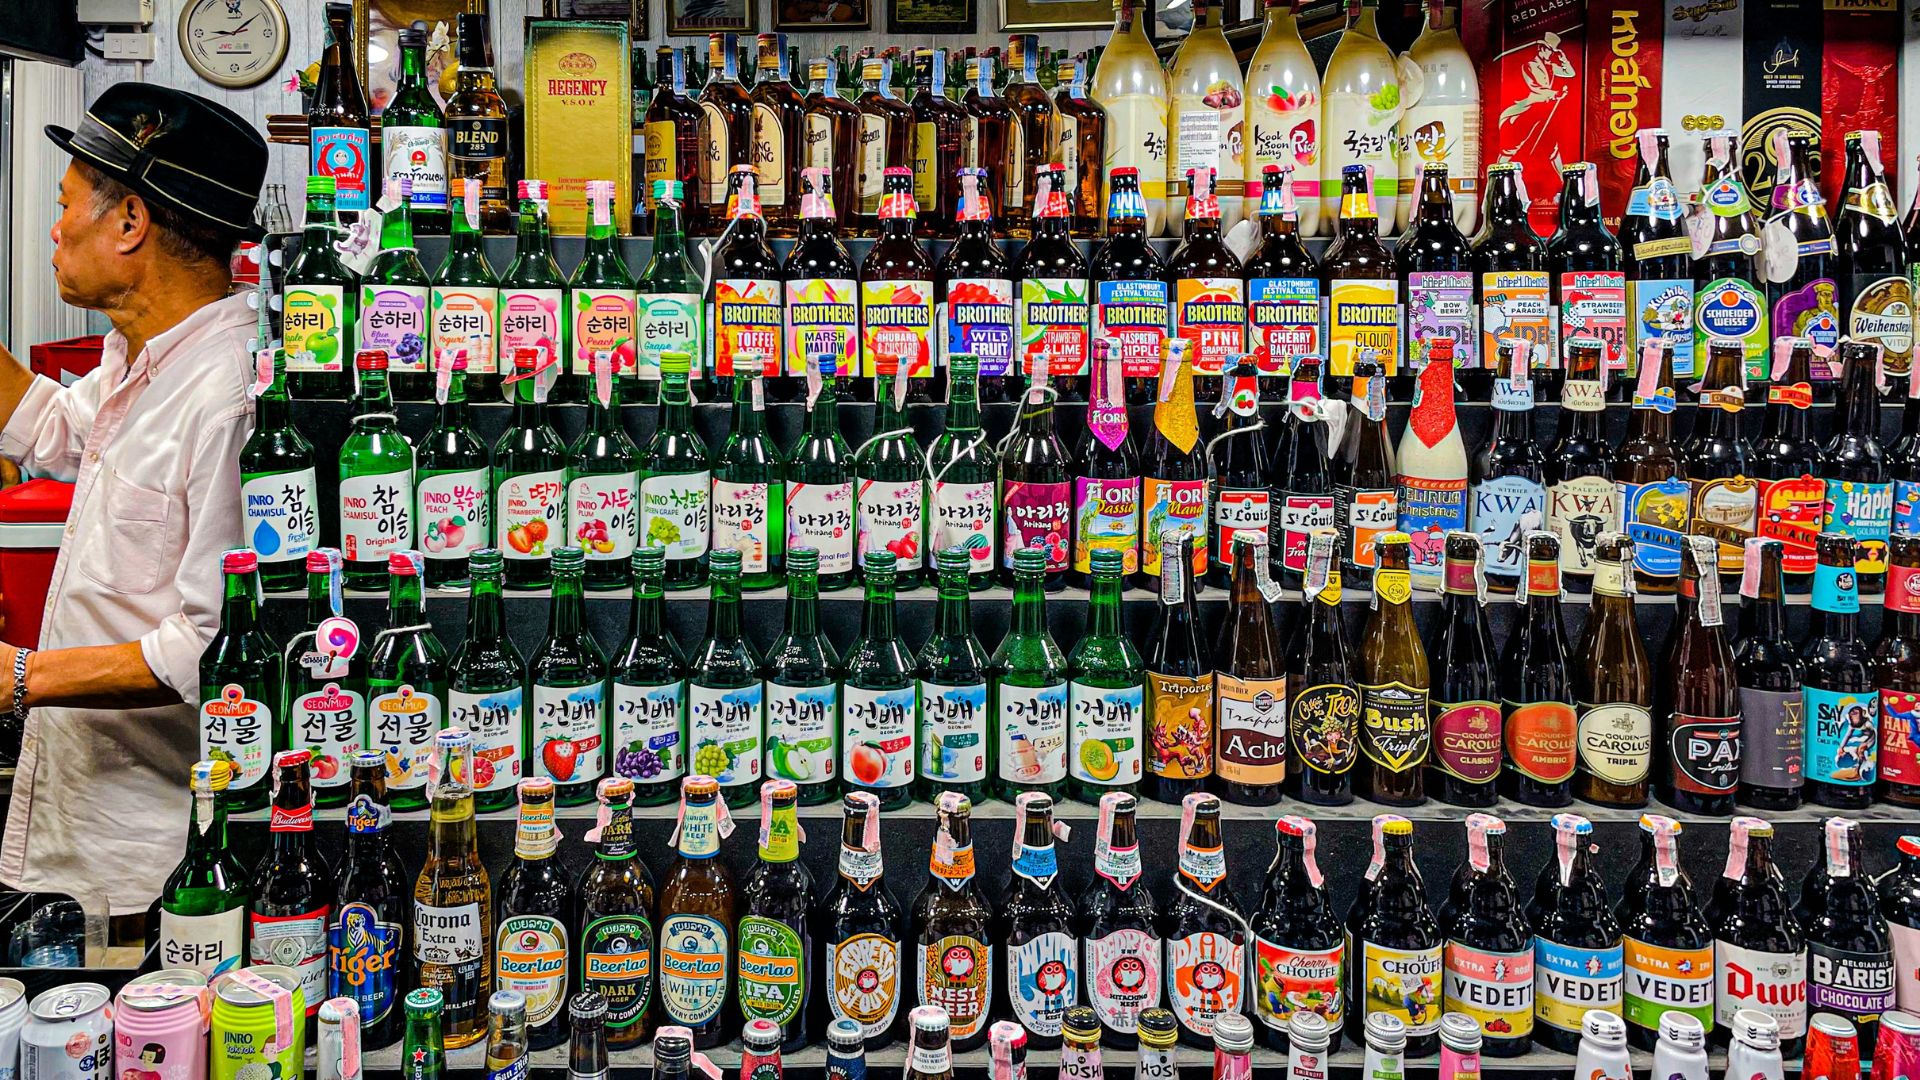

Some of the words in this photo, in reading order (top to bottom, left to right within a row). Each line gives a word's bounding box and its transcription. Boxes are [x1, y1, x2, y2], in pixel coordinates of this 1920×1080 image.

[1511, 8, 1537, 24] RED
[547, 79, 607, 96] REGENCY
[455, 131, 498, 144] BLEND
[1255, 125, 1282, 142] Kook
[469, 143, 486, 151] 285
[1265, 140, 1289, 149] Soon
[1343, 130, 1386, 159] 국순당
[1256, 146, 1282, 159] dang
[285, 312, 324, 331] 순하리
[370, 311, 416, 329] 순하리
[724, 305, 781, 323] BROTHERS
[793, 305, 855, 323] BROTHERS
[867, 307, 929, 325] BROTHERS
[1031, 305, 1087, 323] BROTHERS
[1107, 306, 1166, 324] BROTHERS
[1257, 306, 1318, 324] BROTHERS
[1706, 309, 1754, 319] SCHNEIDER
[439, 314, 483, 332] 순하리
[504, 315, 546, 333] 순하리
[587, 316, 631, 333] 순하리
[645, 321, 688, 338] 순하리
[1713, 318, 1748, 327] WEISSE
[438, 335, 467, 347] Yogurt
[586, 337, 615, 346] Peach
[737, 332, 775, 347] TOFFEE
[805, 333, 845, 341] MARSH
[877, 333, 918, 341] RHUBARB
[971, 332, 1008, 343] WILD
[1043, 333, 1081, 344] STRAWBERRY
[1120, 333, 1159, 345] RASPBERRY
[1202, 332, 1239, 344] PINK
[1271, 333, 1311, 345] CHERRY
[1356, 333, 1392, 347] CLOUDY
[644, 342, 672, 350] Grape
[971, 344, 1008, 356] FRUIT
[248, 494, 274, 506] JINRO
[282, 484, 305, 512] 참
[344, 496, 367, 509] JINRO
[372, 484, 399, 515] 참
[424, 491, 451, 504] JINRO
[508, 498, 527, 507] JINRO
[576, 499, 597, 510] JINRO
[645, 493, 668, 506] JINRO
[1400, 490, 1461, 505] DELIRIUM
[248, 506, 287, 518] CHAMISUL
[343, 508, 379, 520] CHAMISUL
[426, 505, 448, 514] PEACH
[508, 508, 542, 516] STRAWBERRY
[578, 509, 594, 517] PLUM
[660, 508, 679, 516] GRAPE
[715, 503, 764, 524] 아리랑
[868, 501, 920, 521] 아리랑
[939, 504, 992, 523] 아리랑
[1017, 503, 1070, 523] 아리랑
[1235, 509, 1269, 522] Louis
[1402, 503, 1458, 518] Christmas
[288, 506, 316, 536] 이슬
[378, 508, 409, 540] 이슬
[611, 507, 636, 537] 이슬
[685, 504, 708, 532] 이슬
[717, 518, 740, 528] Arirang
[799, 510, 851, 530] 아리랑
[874, 519, 901, 528] Arirang
[945, 520, 972, 530] Arirang
[1023, 520, 1051, 530] Arirang
[1303, 513, 1333, 527] Louis
[805, 529, 832, 537] Arirang
[365, 536, 398, 547] Original
[1390, 587, 1403, 595] 250
[208, 703, 253, 715] SEONMUL
[307, 697, 352, 709] SEONMUL
[382, 699, 425, 711] SEONMUL
[924, 695, 974, 723] 건배
[458, 702, 509, 731] 건배
[545, 697, 596, 726] 건배
[624, 697, 675, 725] 건배
[702, 699, 750, 727] 건배
[777, 697, 824, 726] 건배
[853, 701, 904, 729] 건배
[1013, 697, 1062, 726] 건배
[1081, 698, 1132, 728] 건배
[1817, 703, 1844, 722] SAY
[1365, 707, 1426, 732] Bush
[1884, 716, 1910, 732] HAN
[1817, 721, 1841, 738] PLAY
[1444, 738, 1501, 752] CAROLUS
[1515, 735, 1576, 751] CAROLUS
[1587, 737, 1650, 752] CAROLUS
[1886, 731, 1908, 749] ZA
[1460, 756, 1494, 764] CLASSIC
[1531, 755, 1567, 764] AMBRIO
[1606, 757, 1638, 766] TRIPEL
[273, 814, 313, 825] Budweiser
[348, 815, 377, 831] Tiger
[521, 812, 551, 823] Beerlao
[682, 822, 713, 834] WHITE
[415, 904, 471, 929] Corona
[510, 920, 550, 934] ເບຍລາວ
[602, 925, 638, 935] ເບຍລາວ
[673, 922, 708, 934] ເບຍລາວ
[422, 928, 456, 944] Extra
[166, 940, 223, 966] 순하리
[330, 946, 395, 985] Tiger
[500, 956, 563, 972] Beerlao
[589, 957, 647, 973] Beerlao
[664, 953, 721, 972] Beerlao
[740, 955, 794, 977] Beerlao
[1289, 956, 1328, 968] Cherry
[1454, 958, 1485, 974] EXTRA
[1546, 953, 1579, 969] EXTRA
[1635, 954, 1669, 969] EXTRA
[1842, 959, 1876, 968] BELGIAN
[1275, 963, 1336, 979] CHOUFFE
[362, 992, 384, 1001] BEER
[600, 983, 636, 996] DARK
[669, 981, 713, 998] WHITE
[745, 982, 785, 1000] IPA
[931, 985, 978, 1000] NEST
[1454, 977, 1533, 1007] VEDETT
[1547, 973, 1622, 1006] VEDETT
[1109, 994, 1148, 1002] HITACHINO
[1821, 989, 1882, 1010] CHOCOLATE
[224, 1031, 253, 1044] JINRO
